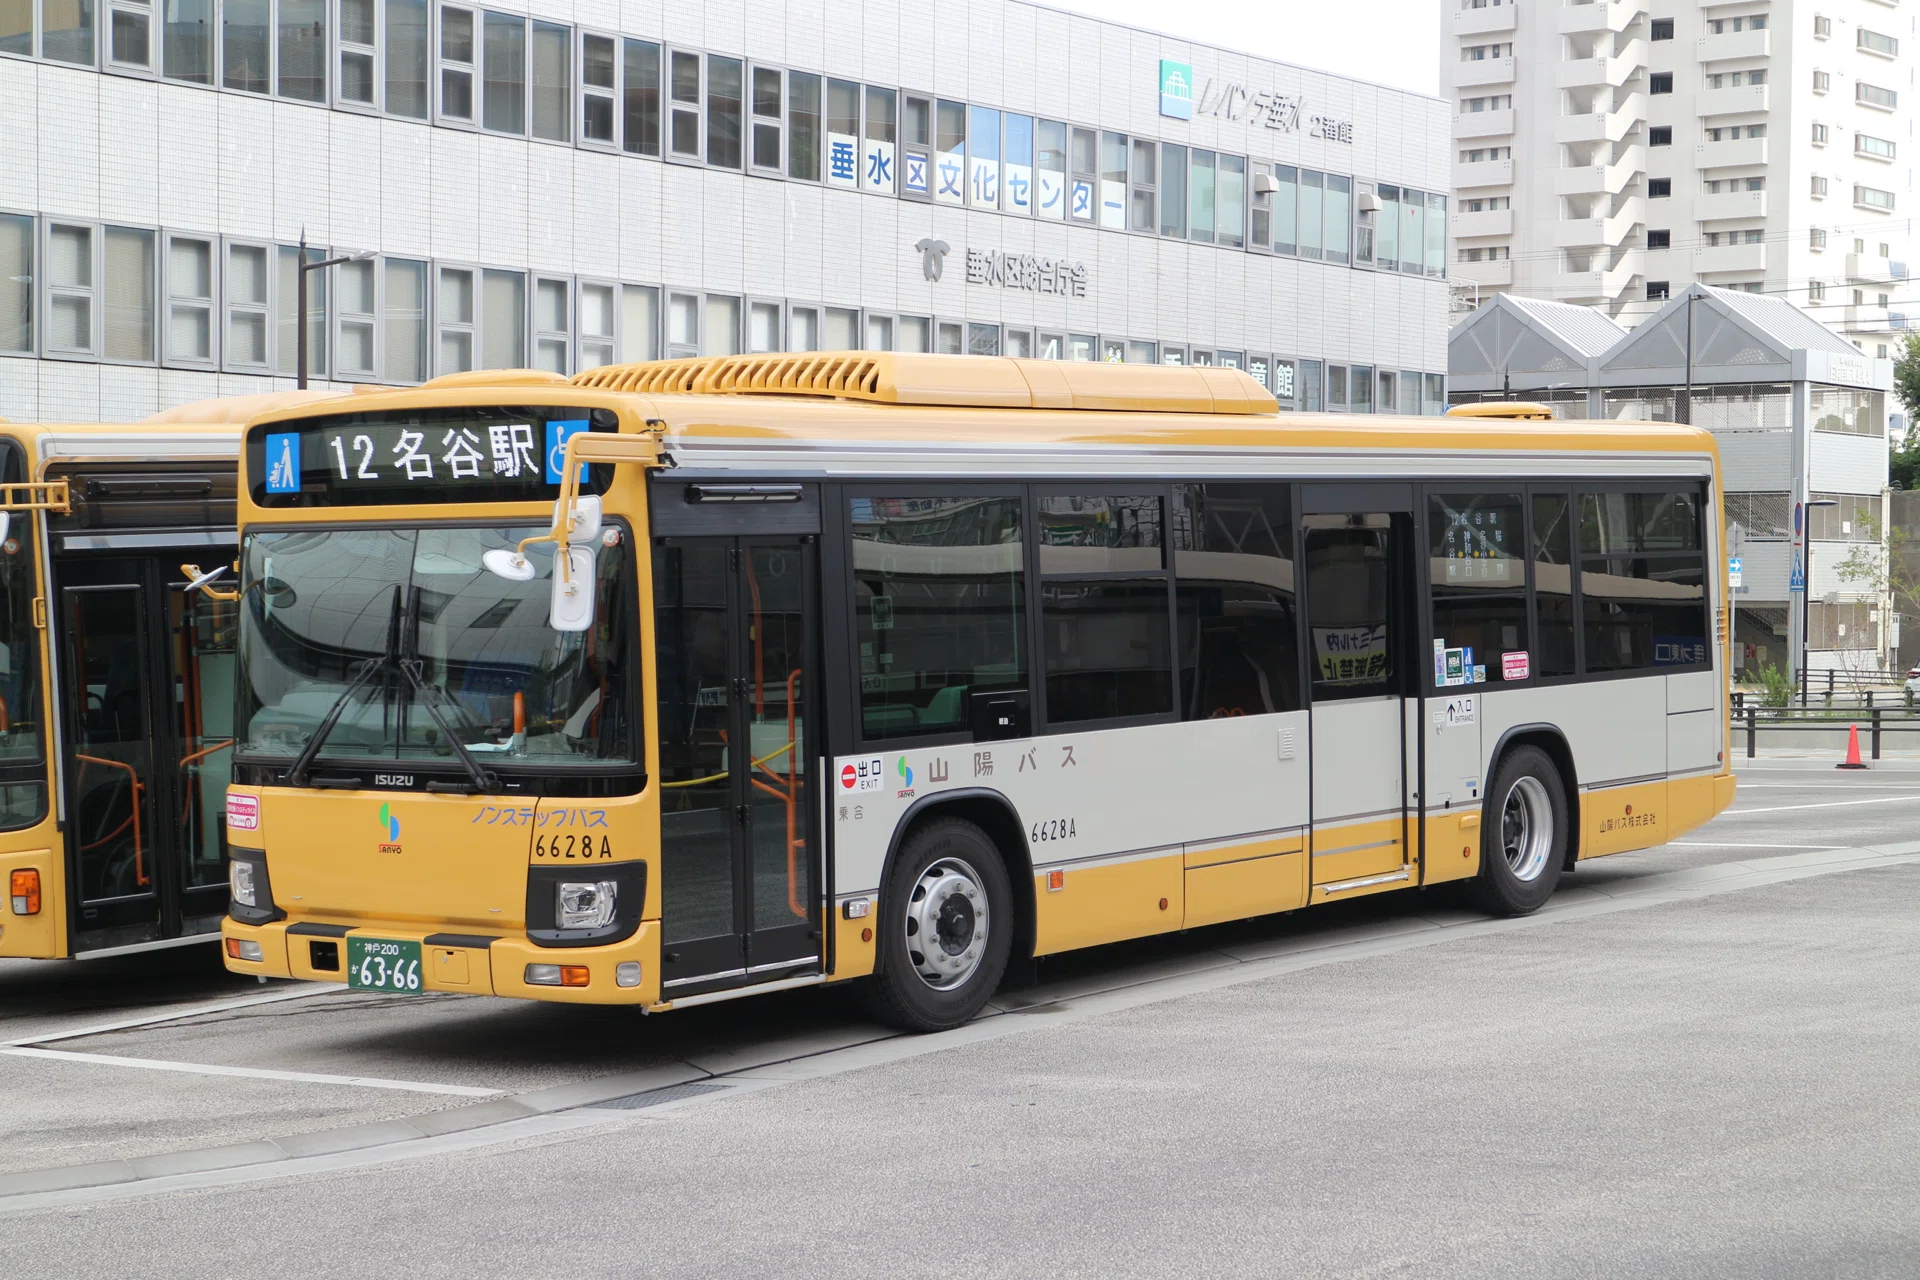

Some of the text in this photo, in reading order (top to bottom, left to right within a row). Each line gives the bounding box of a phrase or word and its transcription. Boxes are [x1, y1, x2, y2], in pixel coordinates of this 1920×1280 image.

[1309, 114, 1353, 144] 2番館
[830, 140, 1123, 212] 垂水区文化センター
[966, 246, 1088, 298] 垂水区総合庁舎
[331, 424, 539, 480] 12 名谷駅
[1457, 699, 1472, 714] 入口
[1455, 713, 1475, 724] ENTRANCE
[858, 759, 881, 779] 出口
[928, 745, 1077, 783] 山陽バス
[375, 774, 414, 787] ISUZU
[860, 778, 878, 790] EXIT
[897, 788, 915, 799] SANYO
[472, 806, 609, 828] ノンステップバス
[838, 804, 864, 822] 乗合
[1600, 813, 1656, 833] 山陽バス株式会社
[1031, 817, 1077, 843] 6628A
[378, 843, 402, 854] SANYO
[535, 835, 613, 859] 6628A
[361, 955, 419, 990] 63-66
